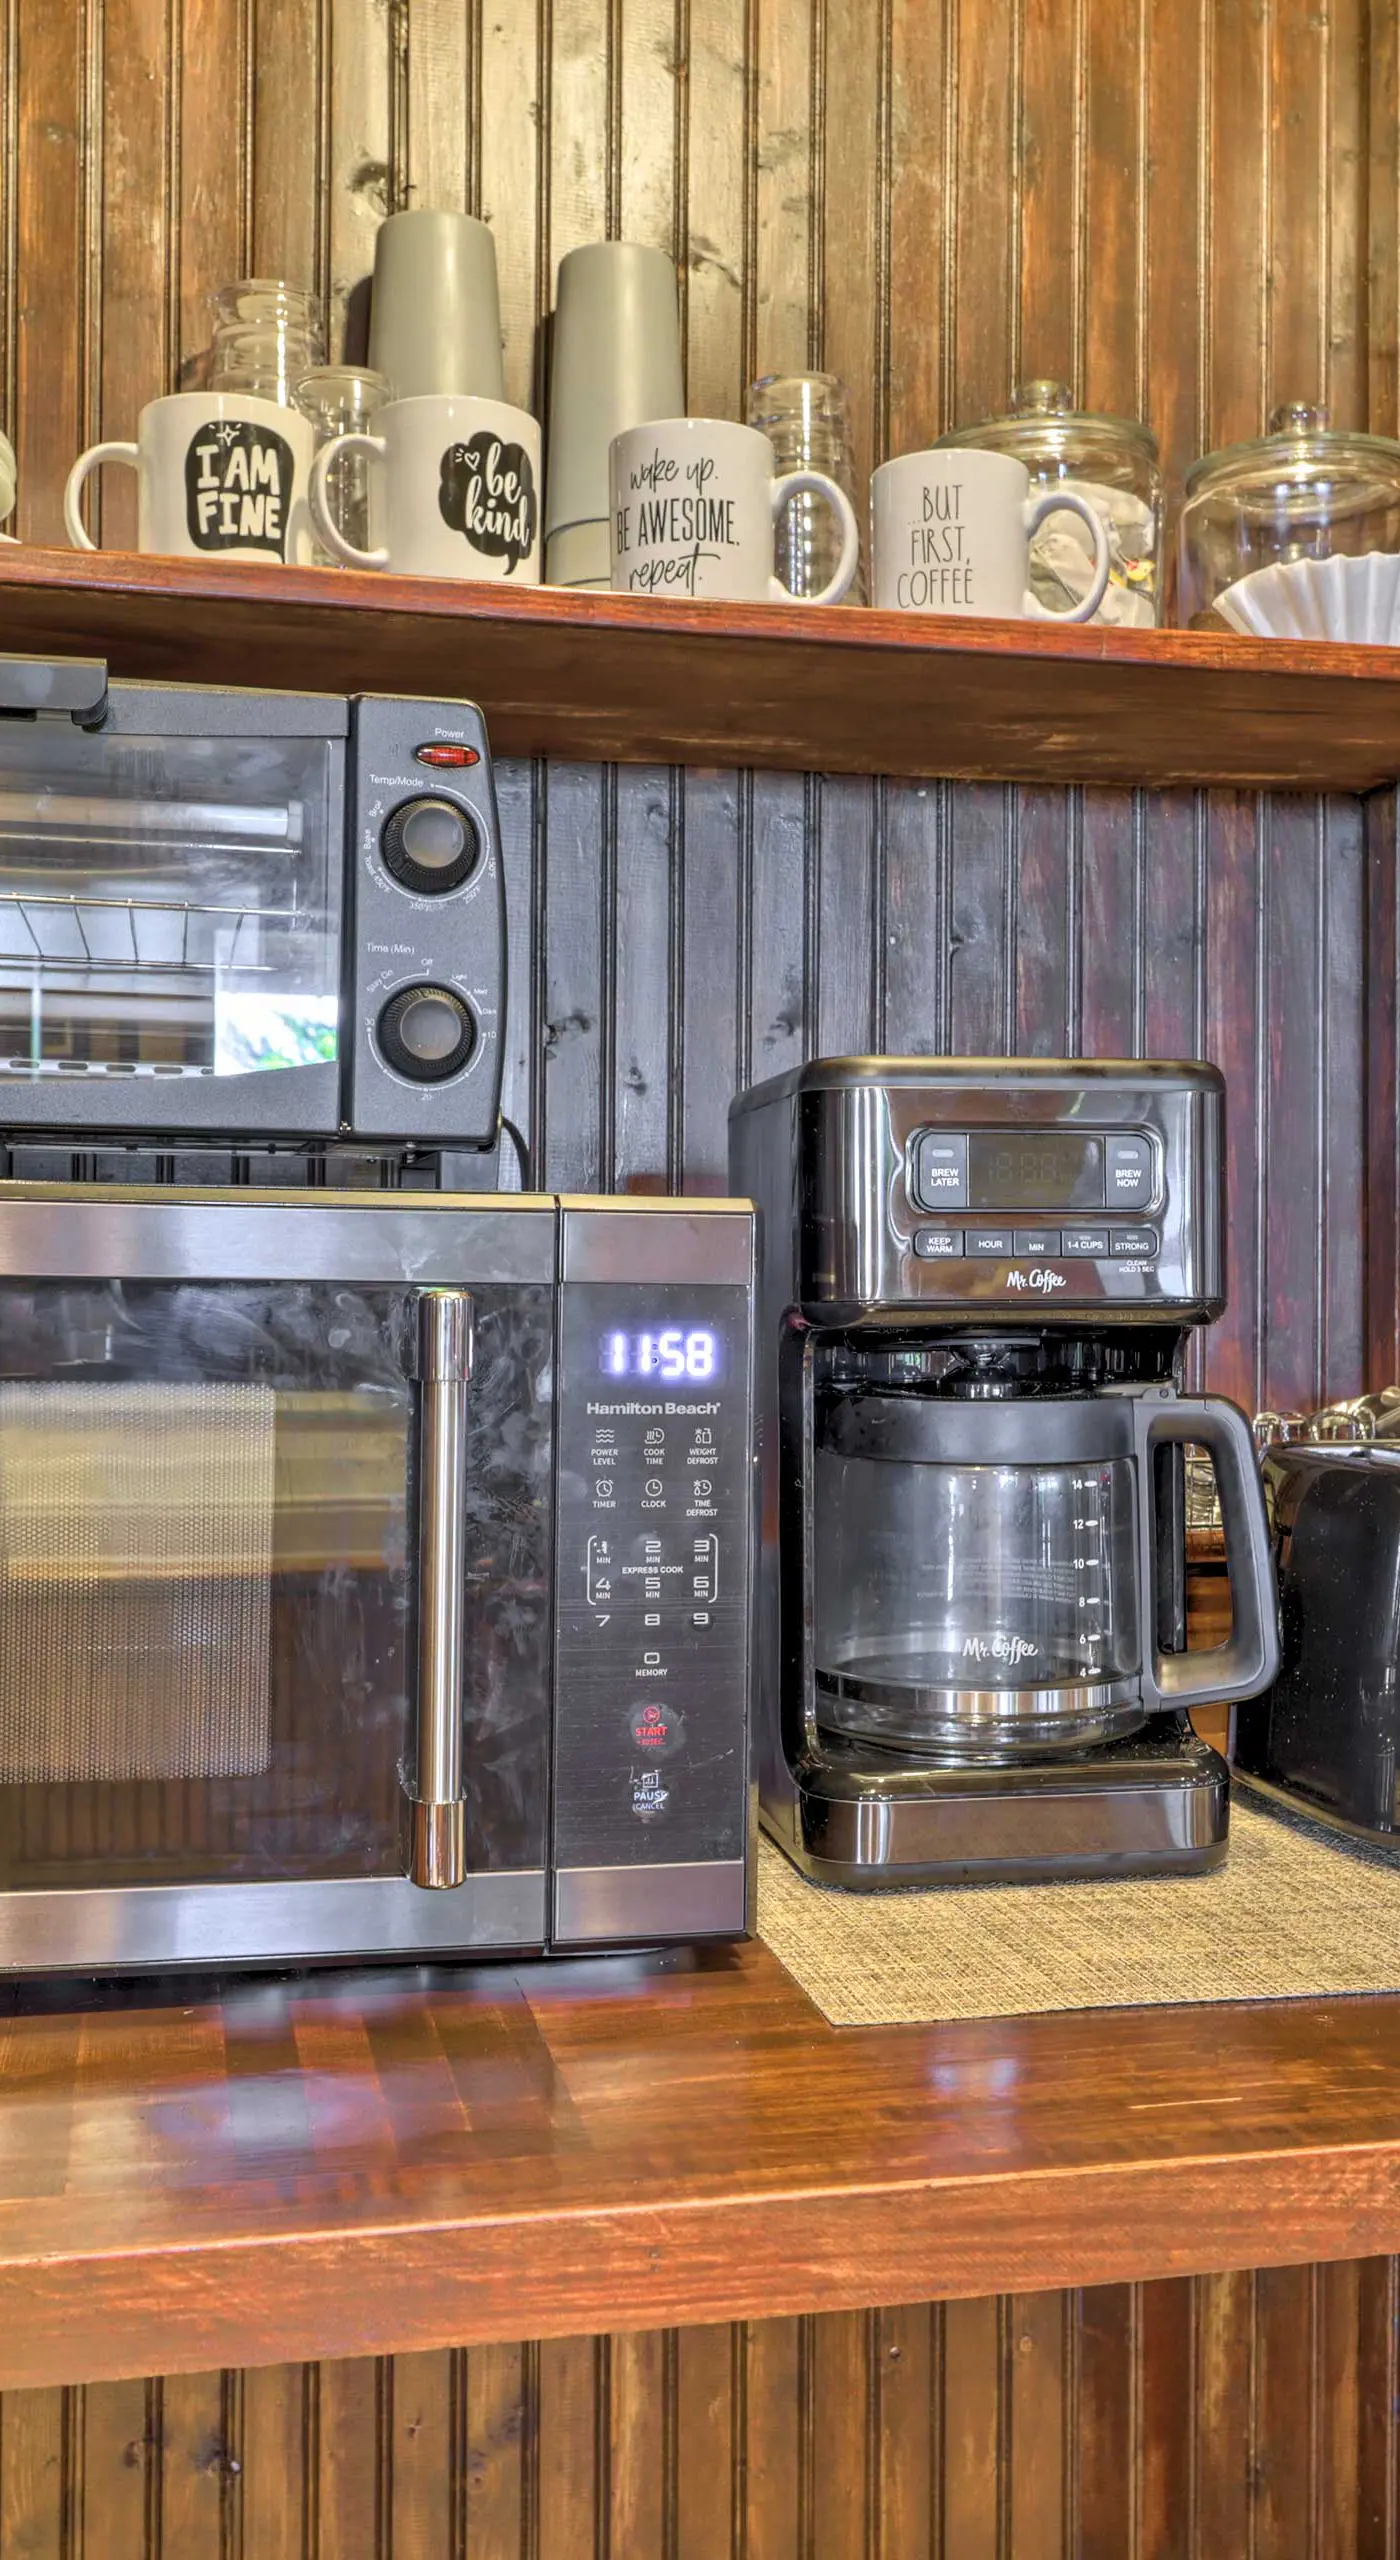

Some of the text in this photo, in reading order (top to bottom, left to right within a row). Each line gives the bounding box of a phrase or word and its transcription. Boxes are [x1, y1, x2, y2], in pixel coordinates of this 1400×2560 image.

[196, 444, 281, 496] I AM
[486, 442, 521, 504] be
[630, 448, 718, 496] wake up.
[197, 490, 282, 540] FINE
[465, 475, 530, 547] kind
[617, 498, 740, 554] BE AWESOME.
[911, 526, 970, 566] FIRST,
[629, 543, 721, 596] repeat.
[897, 568, 974, 609] COFFEE
[434, 728, 465, 739] Power
[369, 774, 424, 787] Temp/Mode
[363, 829, 372, 850] Bake
[367, 943, 415, 957] Time (Min)
[421, 958, 434, 967] Off
[381, 970, 393, 980] On
[364, 1017, 375, 1026] 30
[486, 1030, 497, 1038] 10
[931, 1168, 959, 1177] BREW
[1115, 1169, 1142, 1178] BREW
[930, 1177, 960, 1187] LATER
[1116, 1178, 1139, 1187] NOW
[928, 1237, 951, 1246] KEEP
[978, 1240, 1003, 1249] HOUR
[1067, 1241, 1104, 1249] 1-4 CUPS
[1114, 1242, 1149, 1251] STRONG
[926, 1244, 953, 1254] WARM
[1028, 1243, 1044, 1251] MIN
[1006, 1268, 1067, 1294] Mr. Coffee
[609, 1330, 715, 1379] 11:58
[586, 1402, 663, 1415] Hamilton
[643, 1448, 666, 1456] COOK
[593, 1458, 617, 1466] LEVEL
[686, 1457, 719, 1465] DEFROST
[1072, 1480, 1083, 1490] 14
[592, 1500, 617, 1509] TIMER
[640, 1500, 667, 1508] CLOCK
[694, 1499, 712, 1507] TIME
[685, 1508, 718, 1517] DEFROST
[1073, 1519, 1084, 1530] 12
[645, 1540, 661, 1553] 2
[693, 1539, 710, 1552] 3
[596, 1556, 611, 1564] MIN
[646, 1555, 661, 1564] MIN
[694, 1555, 709, 1563] MIN
[622, 1565, 684, 1574] EXPRESS COOK
[1074, 1560, 1085, 1570] 10
[595, 1577, 611, 1591] 4
[645, 1577, 661, 1589] 5
[693, 1576, 709, 1588] 6
[595, 1592, 611, 1600] MIN
[645, 1591, 660, 1599] MIN
[694, 1590, 709, 1598] MIN
[1079, 1596, 1086, 1608] 8
[595, 1614, 611, 1627] 7
[644, 1614, 660, 1626] 8
[693, 1612, 709, 1625] 9
[1079, 1632, 1086, 1644] 6
[962, 1636, 1039, 1666] Mr. Coffee
[643, 1652, 660, 1664] 0
[635, 1669, 668, 1677] MEMORY
[1079, 1667, 1087, 1678] 4
[635, 1726, 668, 1737] START
